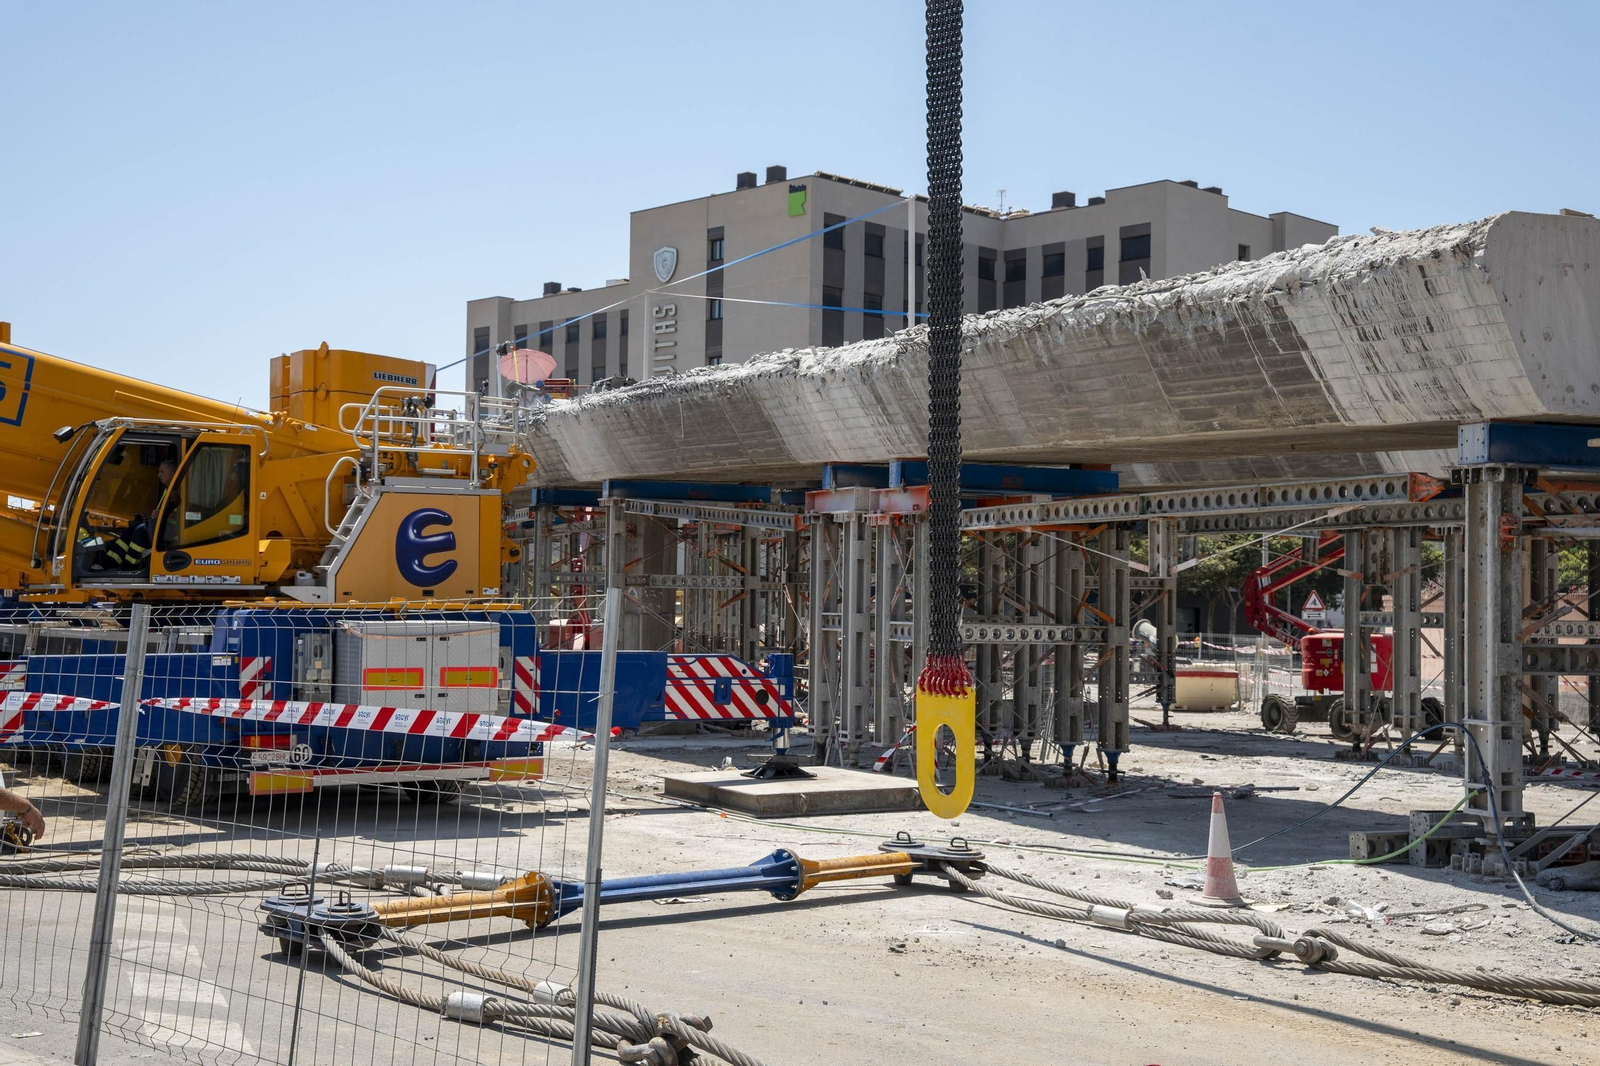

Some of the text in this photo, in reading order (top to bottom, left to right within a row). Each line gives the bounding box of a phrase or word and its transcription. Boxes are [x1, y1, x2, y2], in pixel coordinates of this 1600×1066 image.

[374, 372, 417, 385] LIEBHERR
[396, 507, 458, 587] E
[358, 711, 371, 719] sacyr
[395, 713, 409, 722] sacyr
[294, 747, 309, 763] 60
